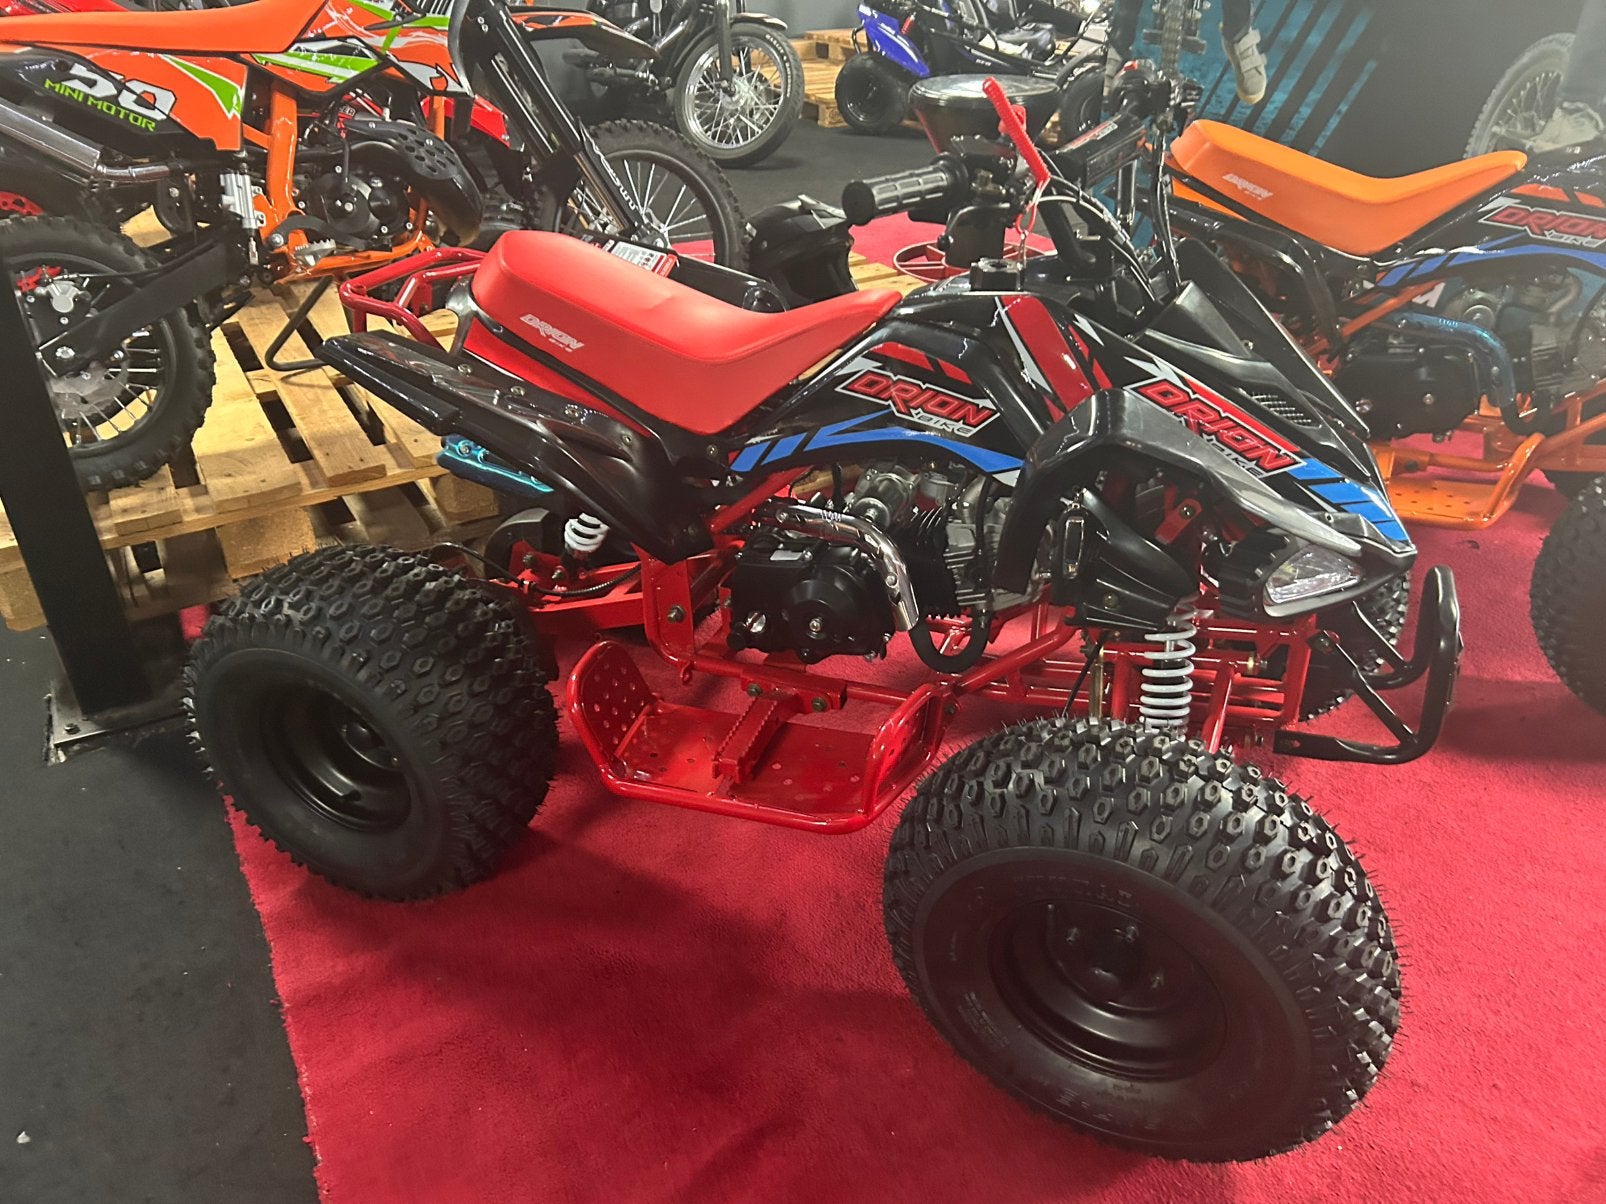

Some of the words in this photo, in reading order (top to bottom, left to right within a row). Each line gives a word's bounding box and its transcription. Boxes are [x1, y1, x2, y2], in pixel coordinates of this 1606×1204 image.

[44, 78, 85, 102] MINI
[87, 95, 156, 132] MOTOR
[519, 313, 585, 350] ORION
[846, 371, 995, 428] ORION
[916, 412, 976, 436] BIKE
[1137, 381, 1297, 471] ORION
